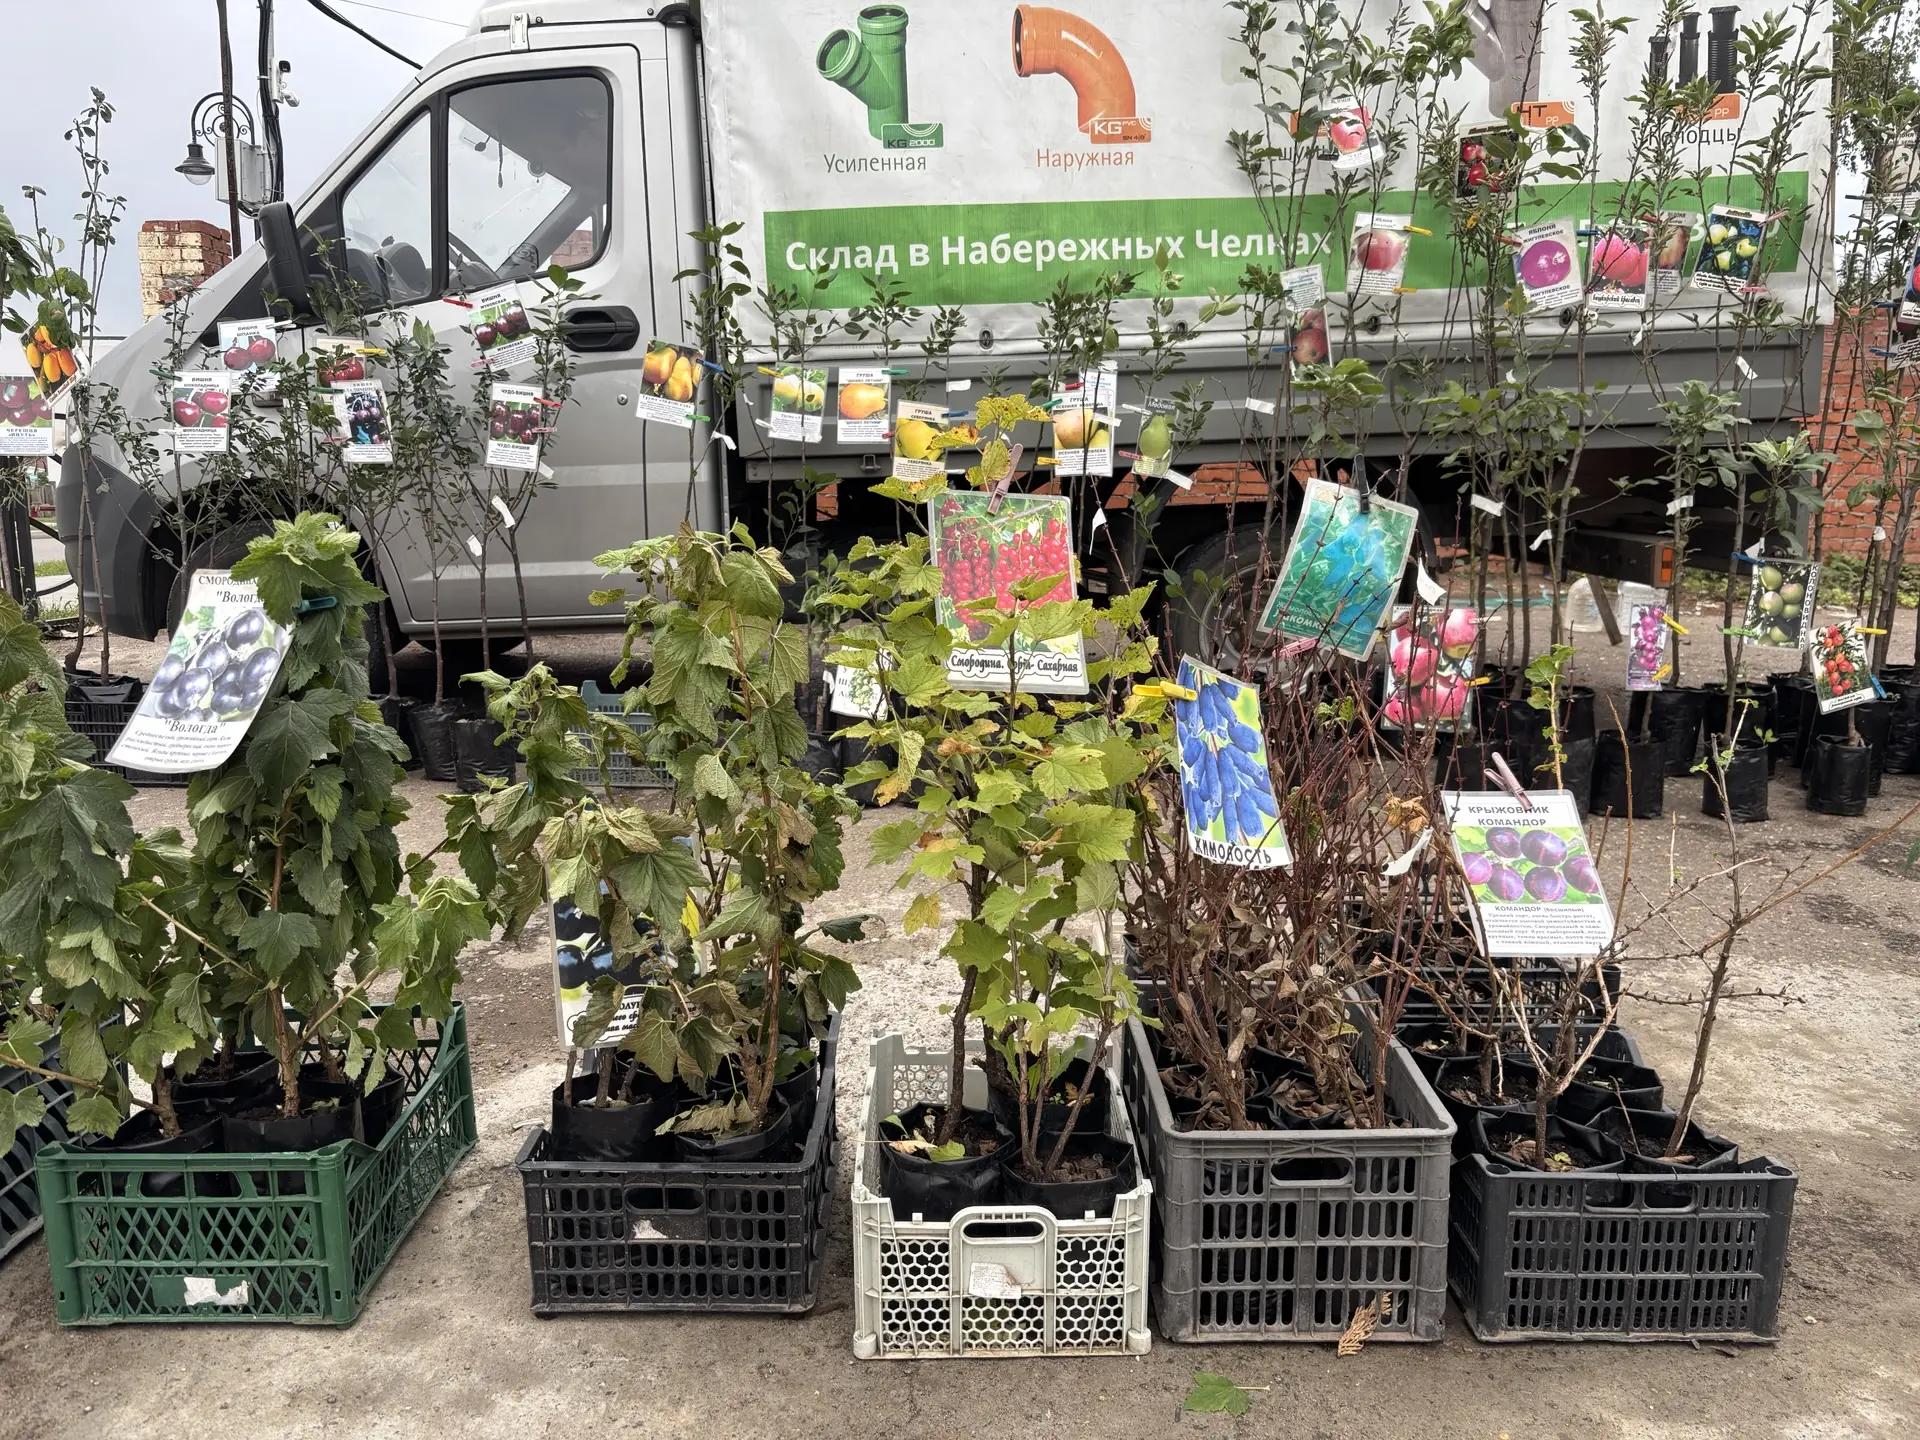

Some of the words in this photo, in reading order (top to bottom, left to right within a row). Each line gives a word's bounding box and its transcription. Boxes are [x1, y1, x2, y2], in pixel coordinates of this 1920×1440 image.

[1094, 121, 1122, 135] KG
[888, 140, 907, 148] KG
[824, 154, 926, 173] Усиленная
[1036, 148, 1134, 172] Наружная
[1528, 224, 1556, 236] ЯБЛОНЯ
[786, 242, 898, 274] Склад
[909, 244, 930, 266] в
[942, 232, 1185, 272] Набережных
[482, 294, 502, 304] ВИШНЯ
[1147, 401, 1175, 410] Медовая
[1800, 564, 1819, 650] КОЛОНОВИДНАЯ
[951, 654, 1004, 672] Смородина.
[1037, 658, 1078, 676] Сахарная
[164, 720, 226, 734] "Вологда"
[1468, 806, 1550, 814] КРЫЖОВНИК
[1194, 836, 1272, 864] ЖИМОЛОСТЬ
